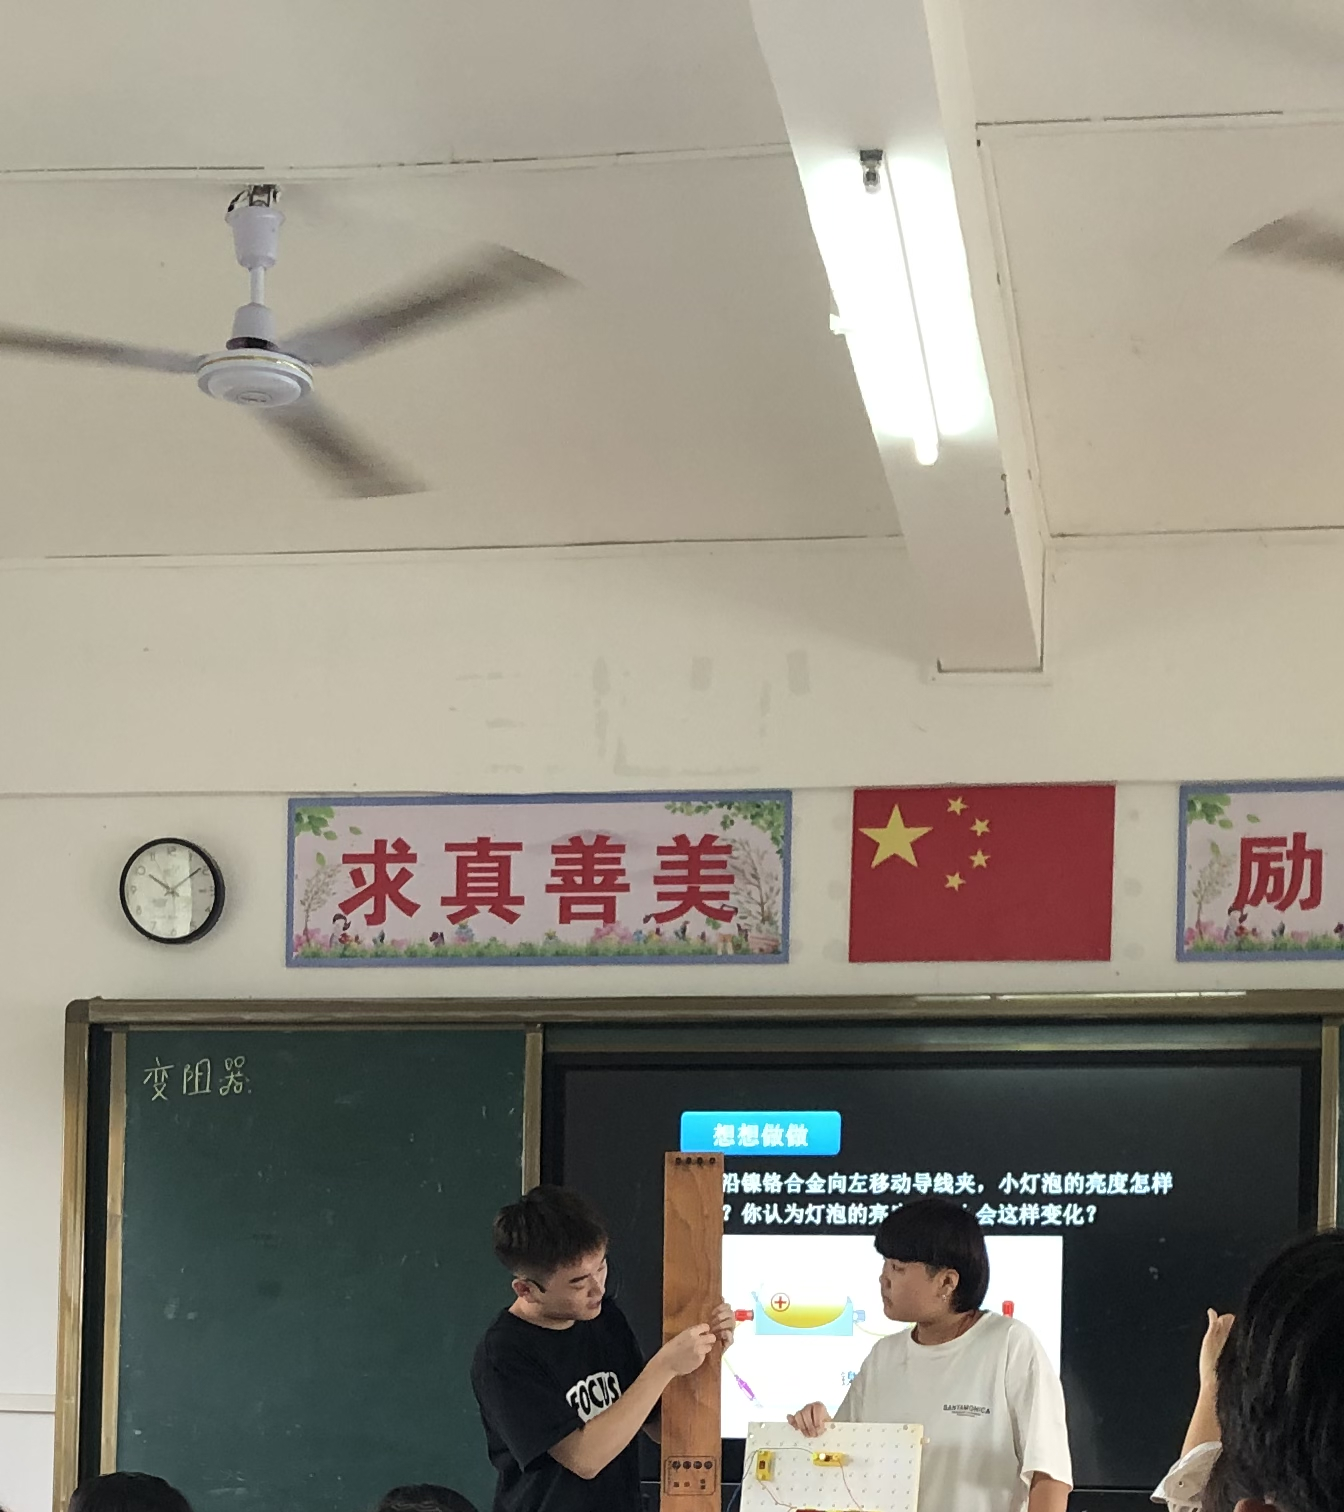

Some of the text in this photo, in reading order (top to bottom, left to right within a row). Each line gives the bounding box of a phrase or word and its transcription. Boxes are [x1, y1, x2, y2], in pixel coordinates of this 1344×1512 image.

[338, 834, 737, 926] 求真善美
[143, 1056, 249, 1101] 变阻器
[712, 1122, 809, 1147] 想想做做
[568, 1375, 621, 1417] FOCUS
